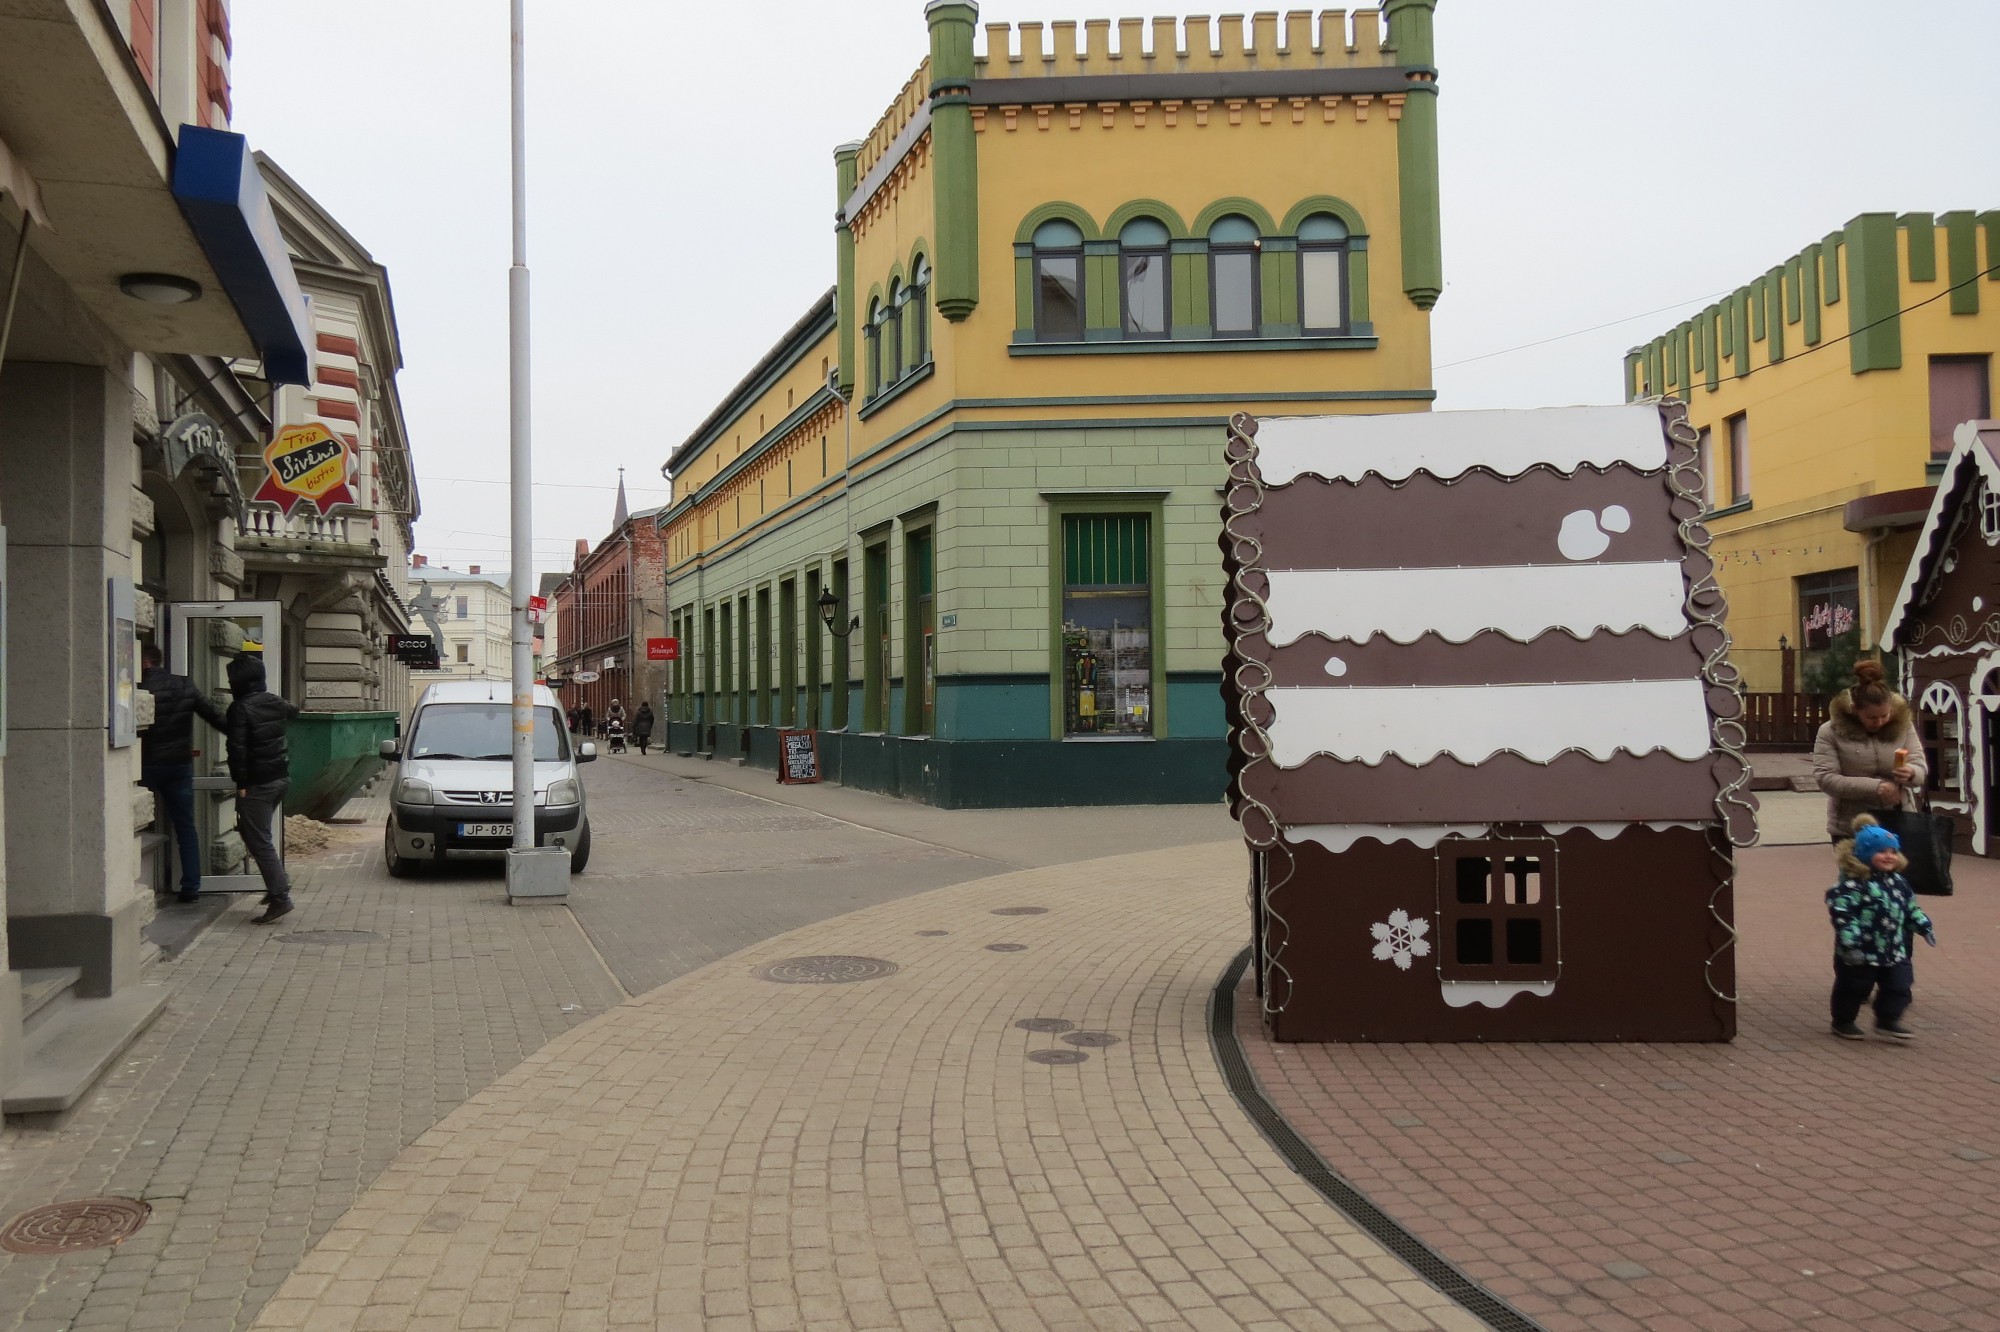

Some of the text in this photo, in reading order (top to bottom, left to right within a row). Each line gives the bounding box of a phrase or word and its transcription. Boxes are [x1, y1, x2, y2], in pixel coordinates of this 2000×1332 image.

[306, 466, 335, 490] bistro
[398, 640, 427, 649] ecco
[650, 646, 674, 655] Triumph
[467, 825, 513, 835] JP-875
